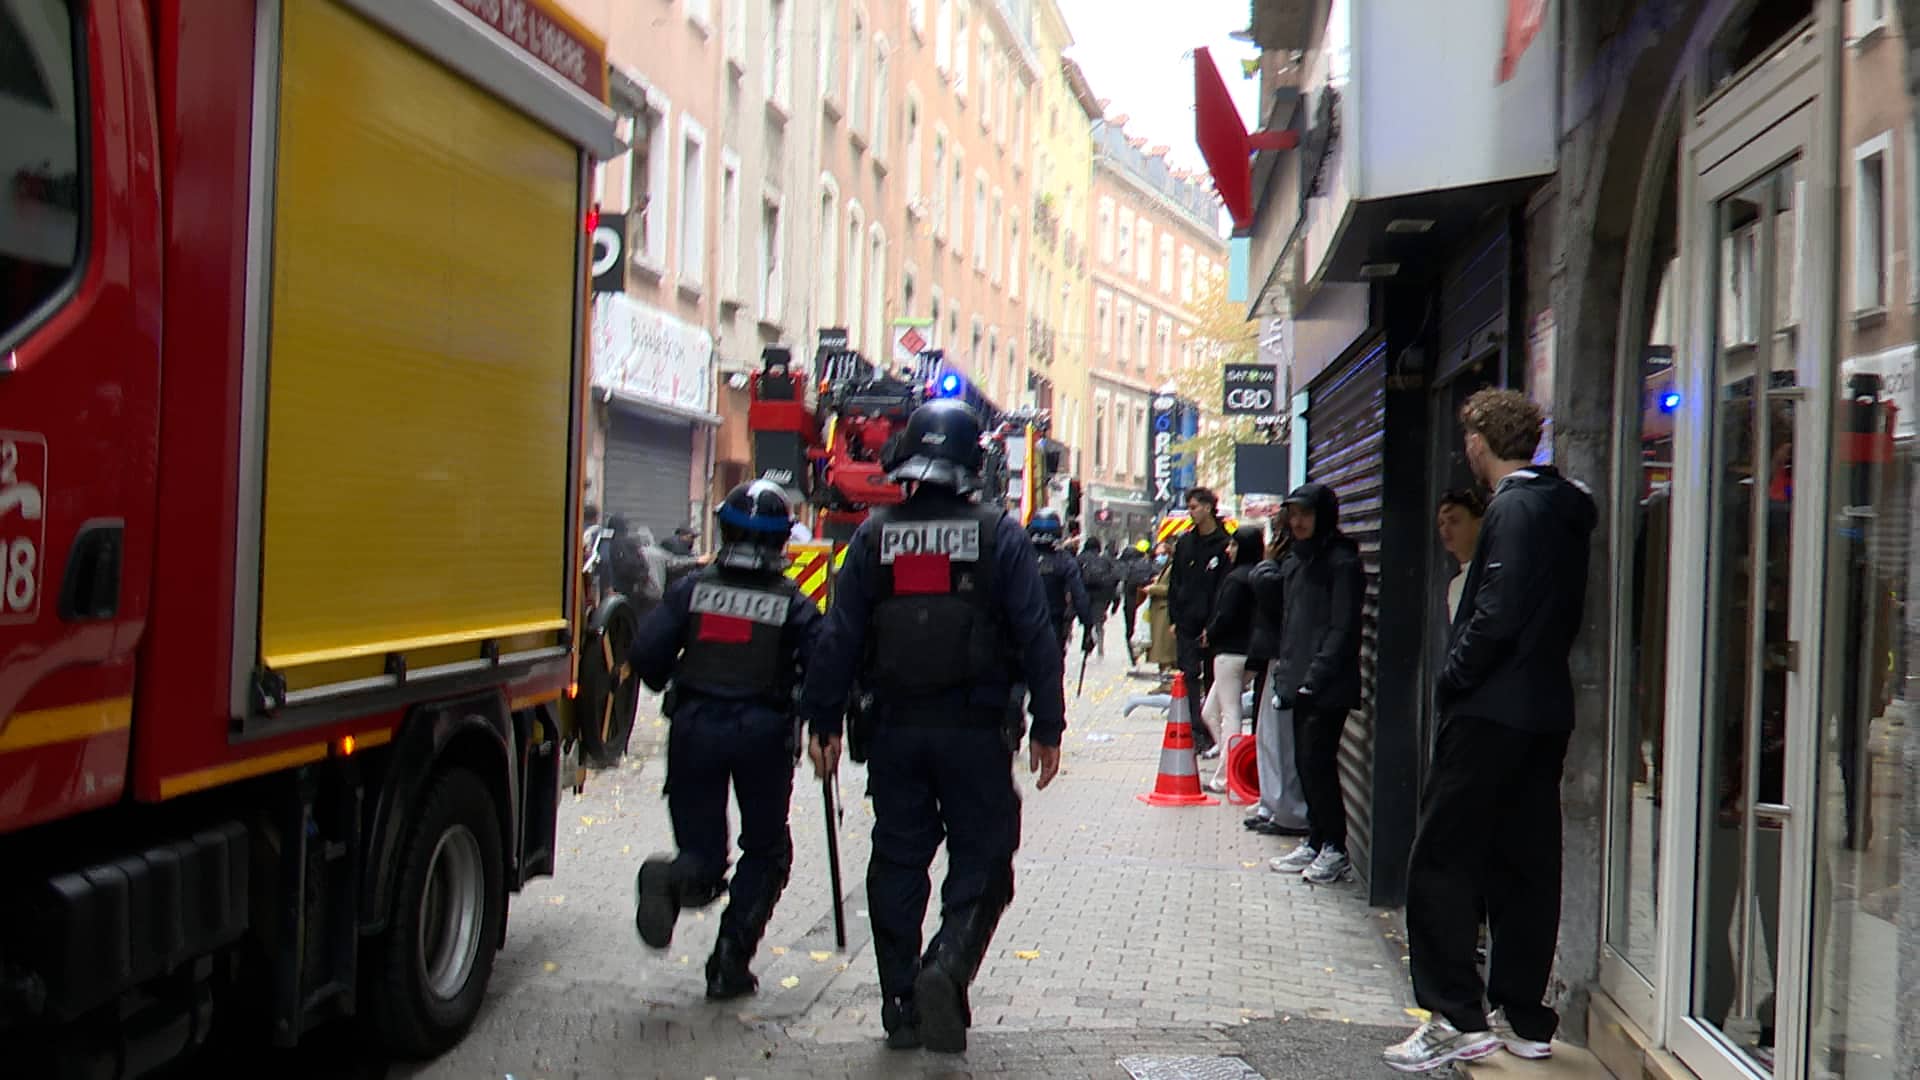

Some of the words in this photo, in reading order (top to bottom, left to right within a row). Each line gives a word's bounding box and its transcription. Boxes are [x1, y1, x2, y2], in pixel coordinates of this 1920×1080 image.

[1227, 389, 1272, 409] CBD
[883, 525, 978, 555] POLICE
[695, 587, 787, 622] POLICE
